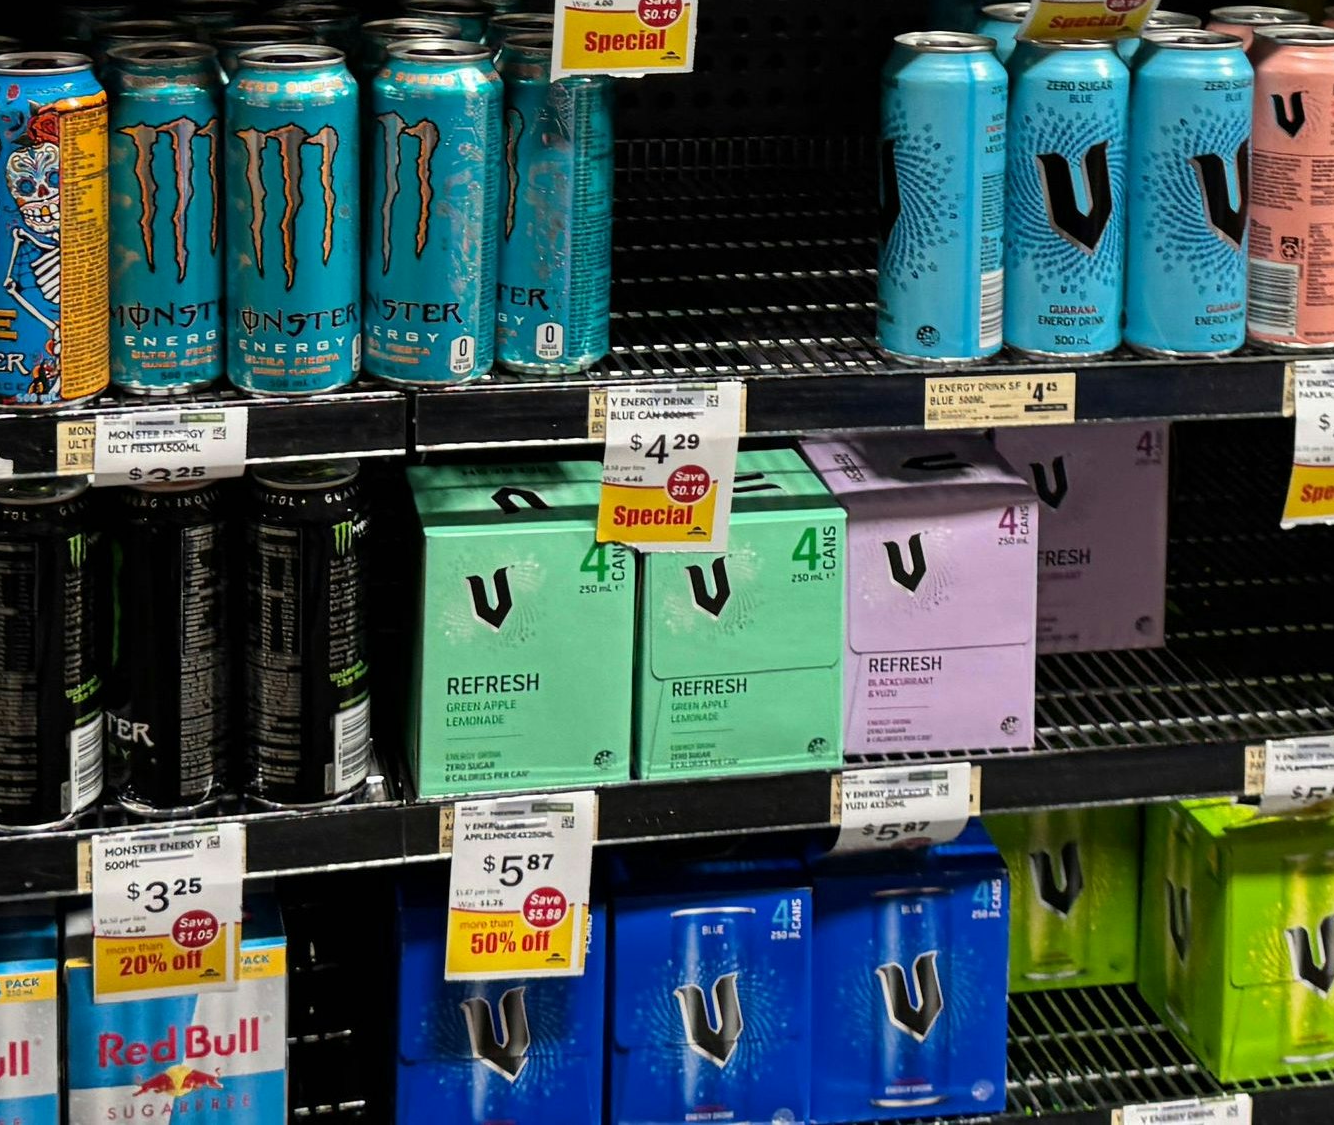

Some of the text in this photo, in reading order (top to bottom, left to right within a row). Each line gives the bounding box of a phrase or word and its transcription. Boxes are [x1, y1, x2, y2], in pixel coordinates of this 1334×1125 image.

[643, 9, 677, 20] $0.16
[1049, 13, 1127, 29] Special
[584, 29, 666, 53] Special
[1046, 80, 1114, 91] ZERO SUGAR
[1069, 93, 1093, 104] BLUE
[1038, 315, 1105, 326] ENERGY DRINK
[238, 336, 344, 354] ENERGY
[939, 382, 1005, 394] ENERGY DRINK
[611, 397, 694, 407] V ENERGY DRINK
[930, 395, 954, 405] BLUE
[610, 411, 635, 421] BLUE
[674, 472, 705, 482] Save
[671, 485, 705, 497] $0.16
[613, 505, 693, 527] Special
[998, 506, 1017, 535] 4
[791, 526, 823, 571] 4
[823, 525, 837, 570] CANS
[868, 656, 943, 674] REFRESH
[446, 673, 541, 696] REFRESH
[671, 677, 748, 698] REFRESH
[446, 698, 517, 713] GREEN APPLE
[445, 713, 505, 728] LEMONADE
[105, 840, 202, 857] MONSTER ENERGY
[530, 894, 561, 905] Save
[528, 909, 561, 921] $5.88
[179, 917, 212, 928] Save
[490, 919, 514, 929] than
[178, 929, 214, 943] $1.05
[471, 931, 551, 955] 50% off
[120, 951, 203, 976] 20% off
[5, 976, 40, 990] PACK
[97, 1017, 260, 1069] Red Bull
